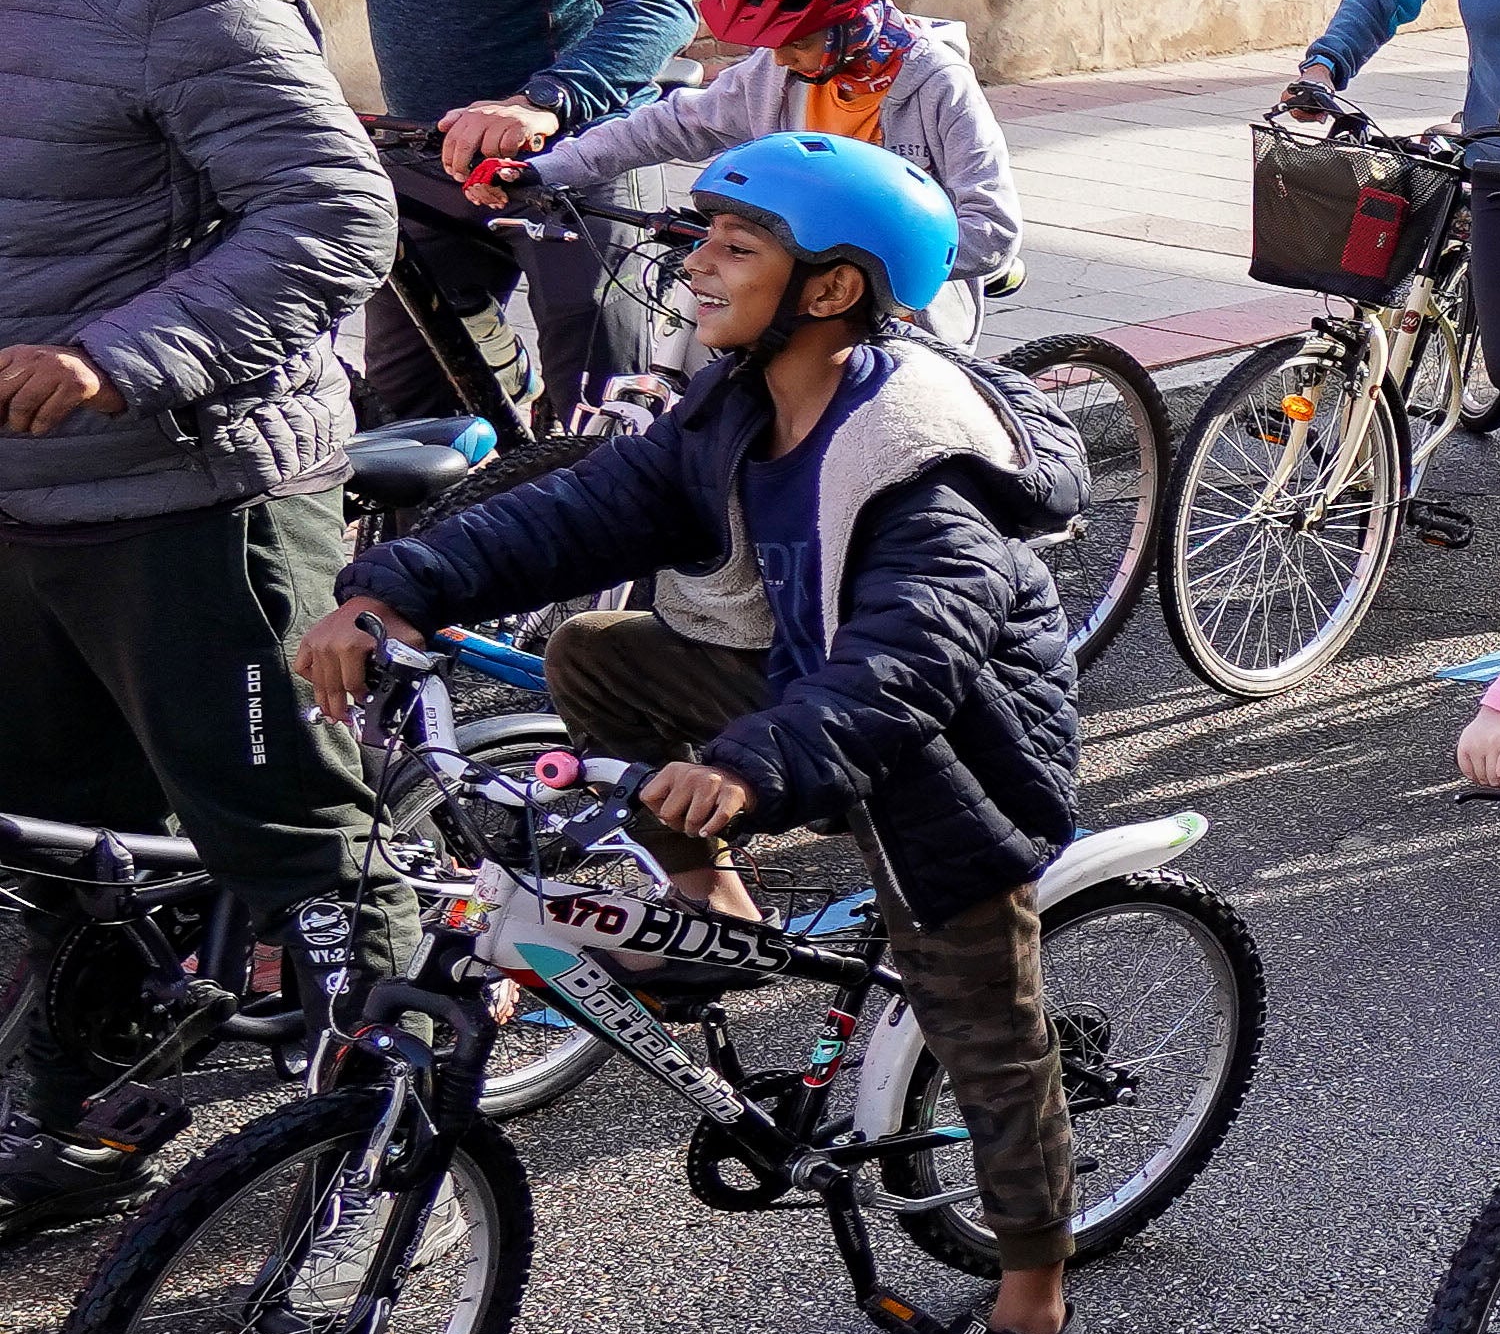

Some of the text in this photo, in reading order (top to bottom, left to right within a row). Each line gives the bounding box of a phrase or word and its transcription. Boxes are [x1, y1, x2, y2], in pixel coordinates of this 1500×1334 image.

[249, 698, 266, 766] SECTION
[544, 898, 794, 973] 470 BOSS
